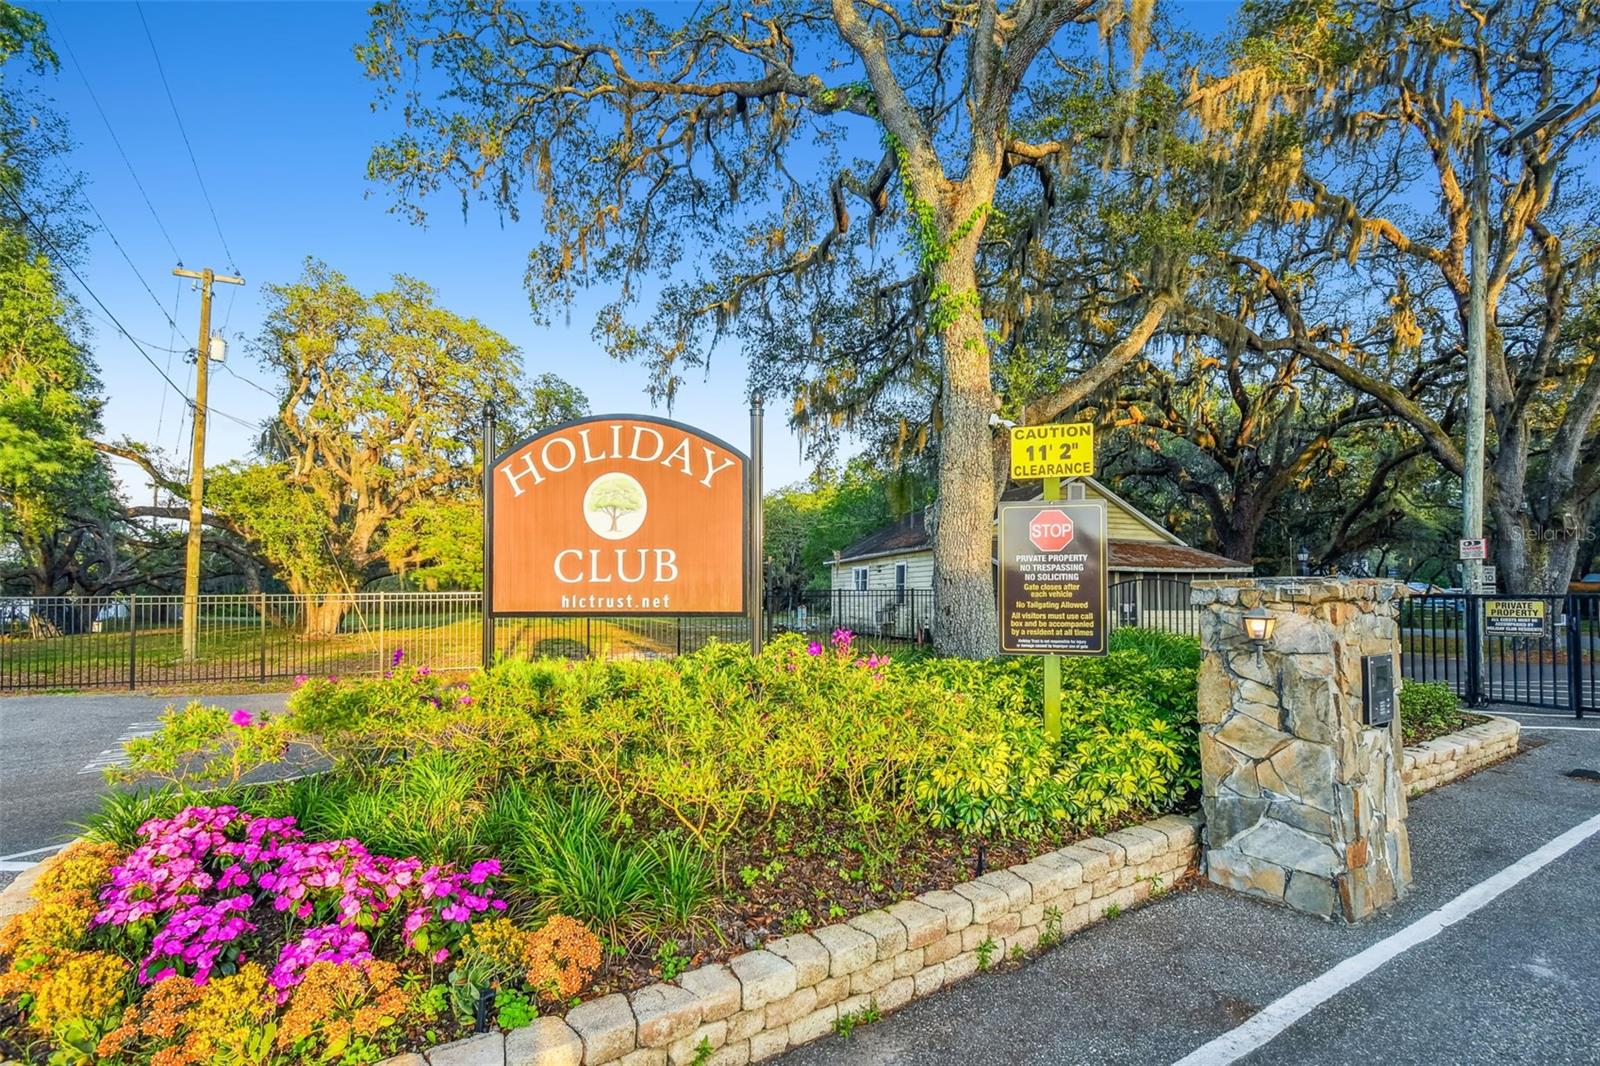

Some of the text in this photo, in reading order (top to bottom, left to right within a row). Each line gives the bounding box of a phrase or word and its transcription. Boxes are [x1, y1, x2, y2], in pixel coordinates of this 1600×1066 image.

[1014, 425, 1091, 440] CAUTION
[1026, 442, 1078, 461] 11' 2"
[501, 424, 736, 498] HOLIDAY
[1014, 462, 1091, 477] CLEARANCE
[1031, 523, 1072, 538] STOP
[1015, 554, 1088, 562] PRIVATE PROPERTY
[553, 548, 679, 584] CLUB
[1020, 563, 1084, 572] NO TRESPASSING
[1024, 573, 1079, 581] NO SOLICITING
[1484, 574, 1494, 582] 10
[1023, 583, 1080, 591] Gate closes after
[1048, 590, 1073, 598] vehicle
[561, 594, 670, 609] hlctrust.net
[1016, 601, 1089, 610] No Tailgating Allowed
[1080, 612, 1094, 620] call
[1048, 620, 1094, 629] accompanied
[1011, 628, 1020, 636] by
[1026, 628, 1055, 636] resident
